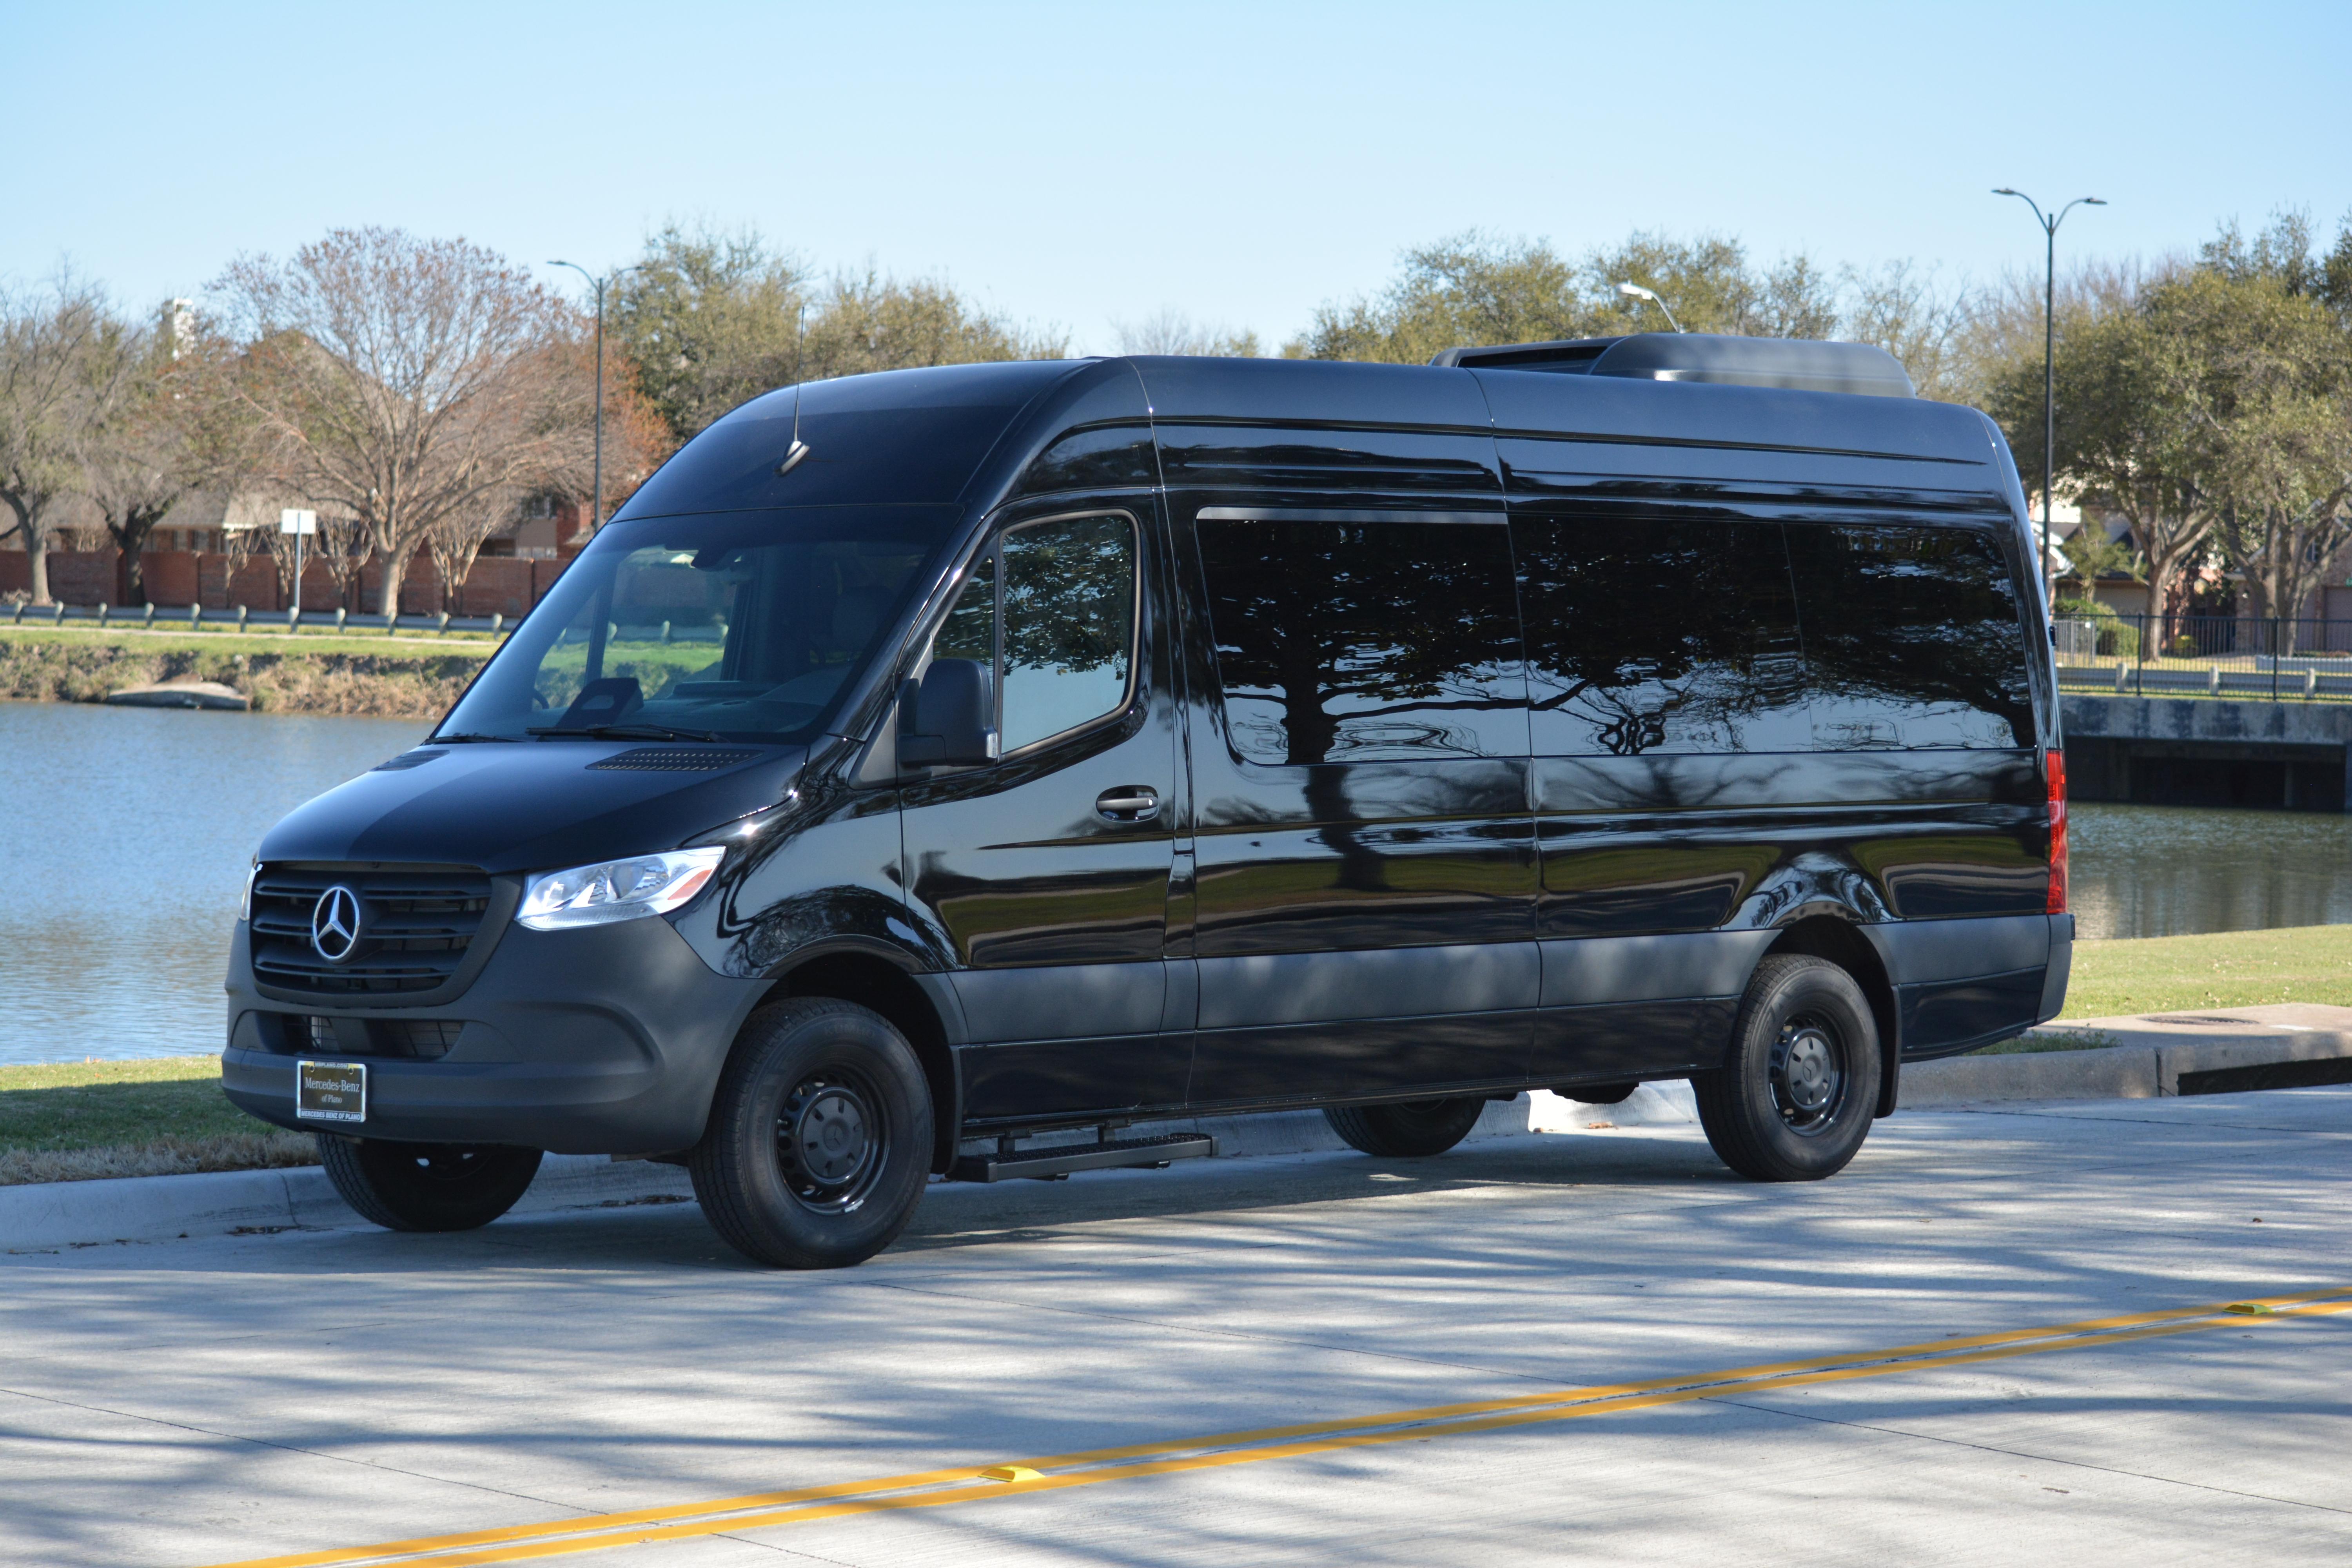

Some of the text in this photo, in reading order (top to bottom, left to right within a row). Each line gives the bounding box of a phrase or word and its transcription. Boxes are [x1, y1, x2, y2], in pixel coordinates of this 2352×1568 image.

[824, 1024, 877, 1037] KUMHO
[305, 1077, 360, 1093] Mercedes-Benz
[328, 1094, 342, 1103] Plano
[301, 1110, 325, 1118] MERCEDES
